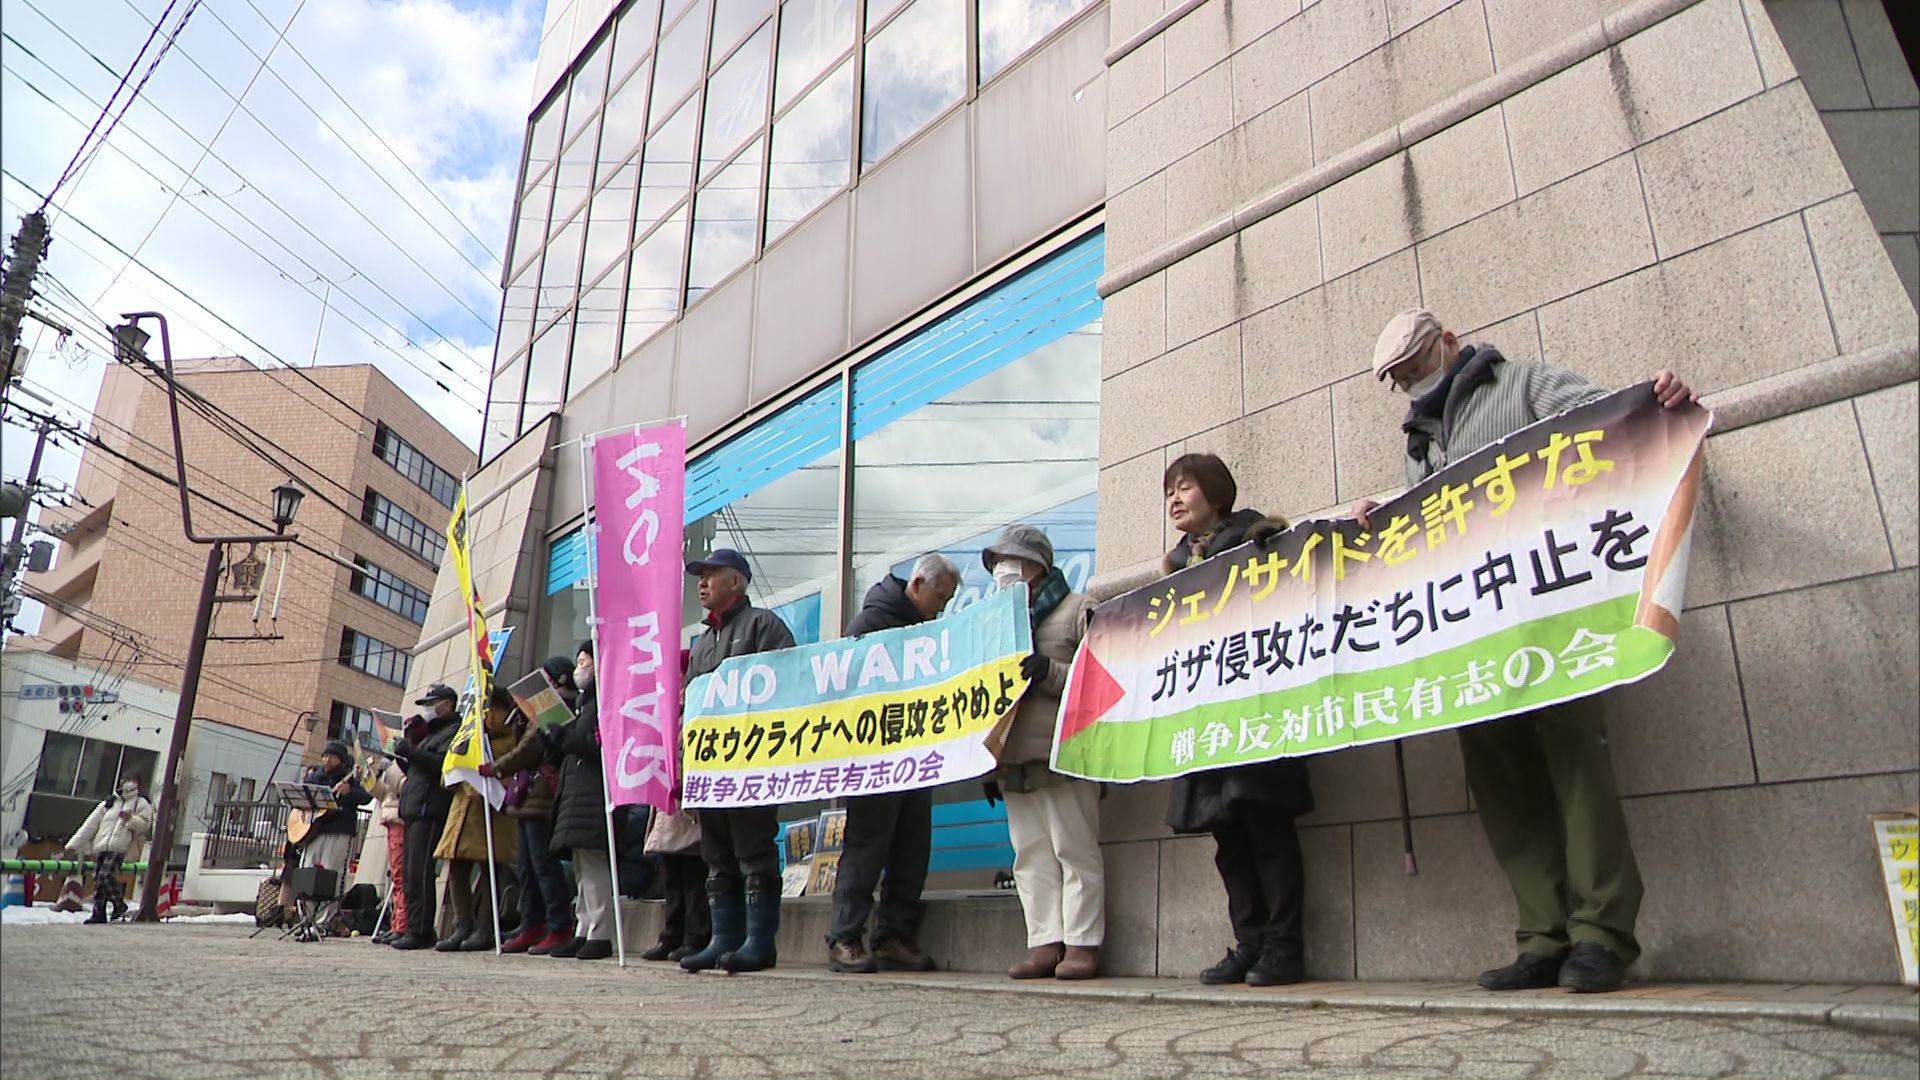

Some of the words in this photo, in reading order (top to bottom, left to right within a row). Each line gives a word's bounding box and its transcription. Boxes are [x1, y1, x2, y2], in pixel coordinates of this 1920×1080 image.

[1147, 429, 1616, 638] ジェノサイドを許すな
[1152, 509, 1649, 702] ガザ侵攻ただちに中止を
[688, 672, 1014, 763] はウクライナへの侵攻をやめよ
[702, 664, 777, 709] NO
[811, 628, 951, 695] WAR!
[1168, 627, 1619, 768] 戦争反対市民有志の会
[684, 750, 945, 803] 戦争反対市民有志の会
